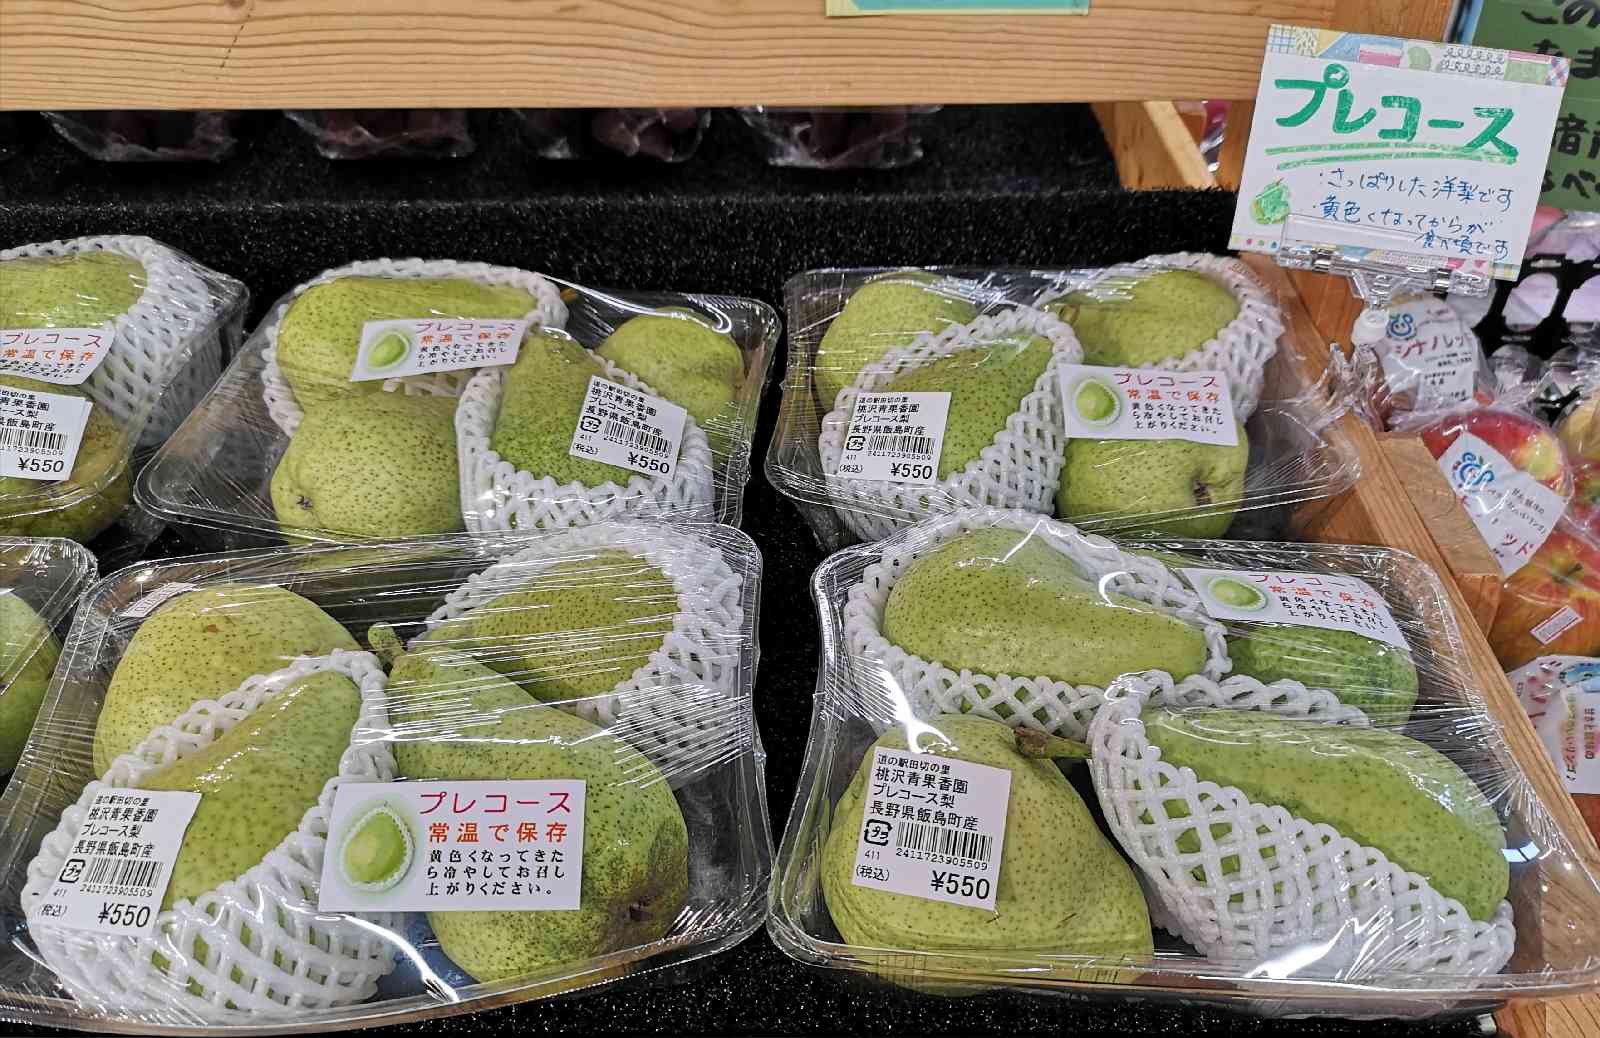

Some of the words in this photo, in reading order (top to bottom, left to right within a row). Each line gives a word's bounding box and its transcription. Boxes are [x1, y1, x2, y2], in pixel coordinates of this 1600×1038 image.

[1275, 63, 1518, 156] プレコース
[1114, 372, 1219, 387] プレコース
[18, 457, 65, 473] ¥550
[628, 451, 670, 474] ¥550
[890, 462, 933, 480] ¥550
[877, 753, 951, 775] 道の駅田切の里
[874, 766, 968, 795] 桃沢青果香園
[419, 790, 571, 815] プレコース
[873, 783, 955, 809] プレコース梨
[88, 807, 159, 823] 桃沢青果香園
[870, 800, 980, 831] 長野県飯島町産
[81, 823, 143, 838] プレコース梨
[428, 821, 568, 844] 常温で保存
[73, 839, 155, 858] 長野県飯島町産
[429, 848, 564, 864] 黄色くなってきた
[864, 849, 881, 861] 411
[896, 847, 988, 871] 2411723905509
[426, 865, 566, 880] ら冷やしてお召し
[855, 863, 890, 882] (税込)
[930, 869, 991, 900] ¥550
[425, 881, 553, 897] 上がりください。
[97, 901, 151, 928] ¥550
